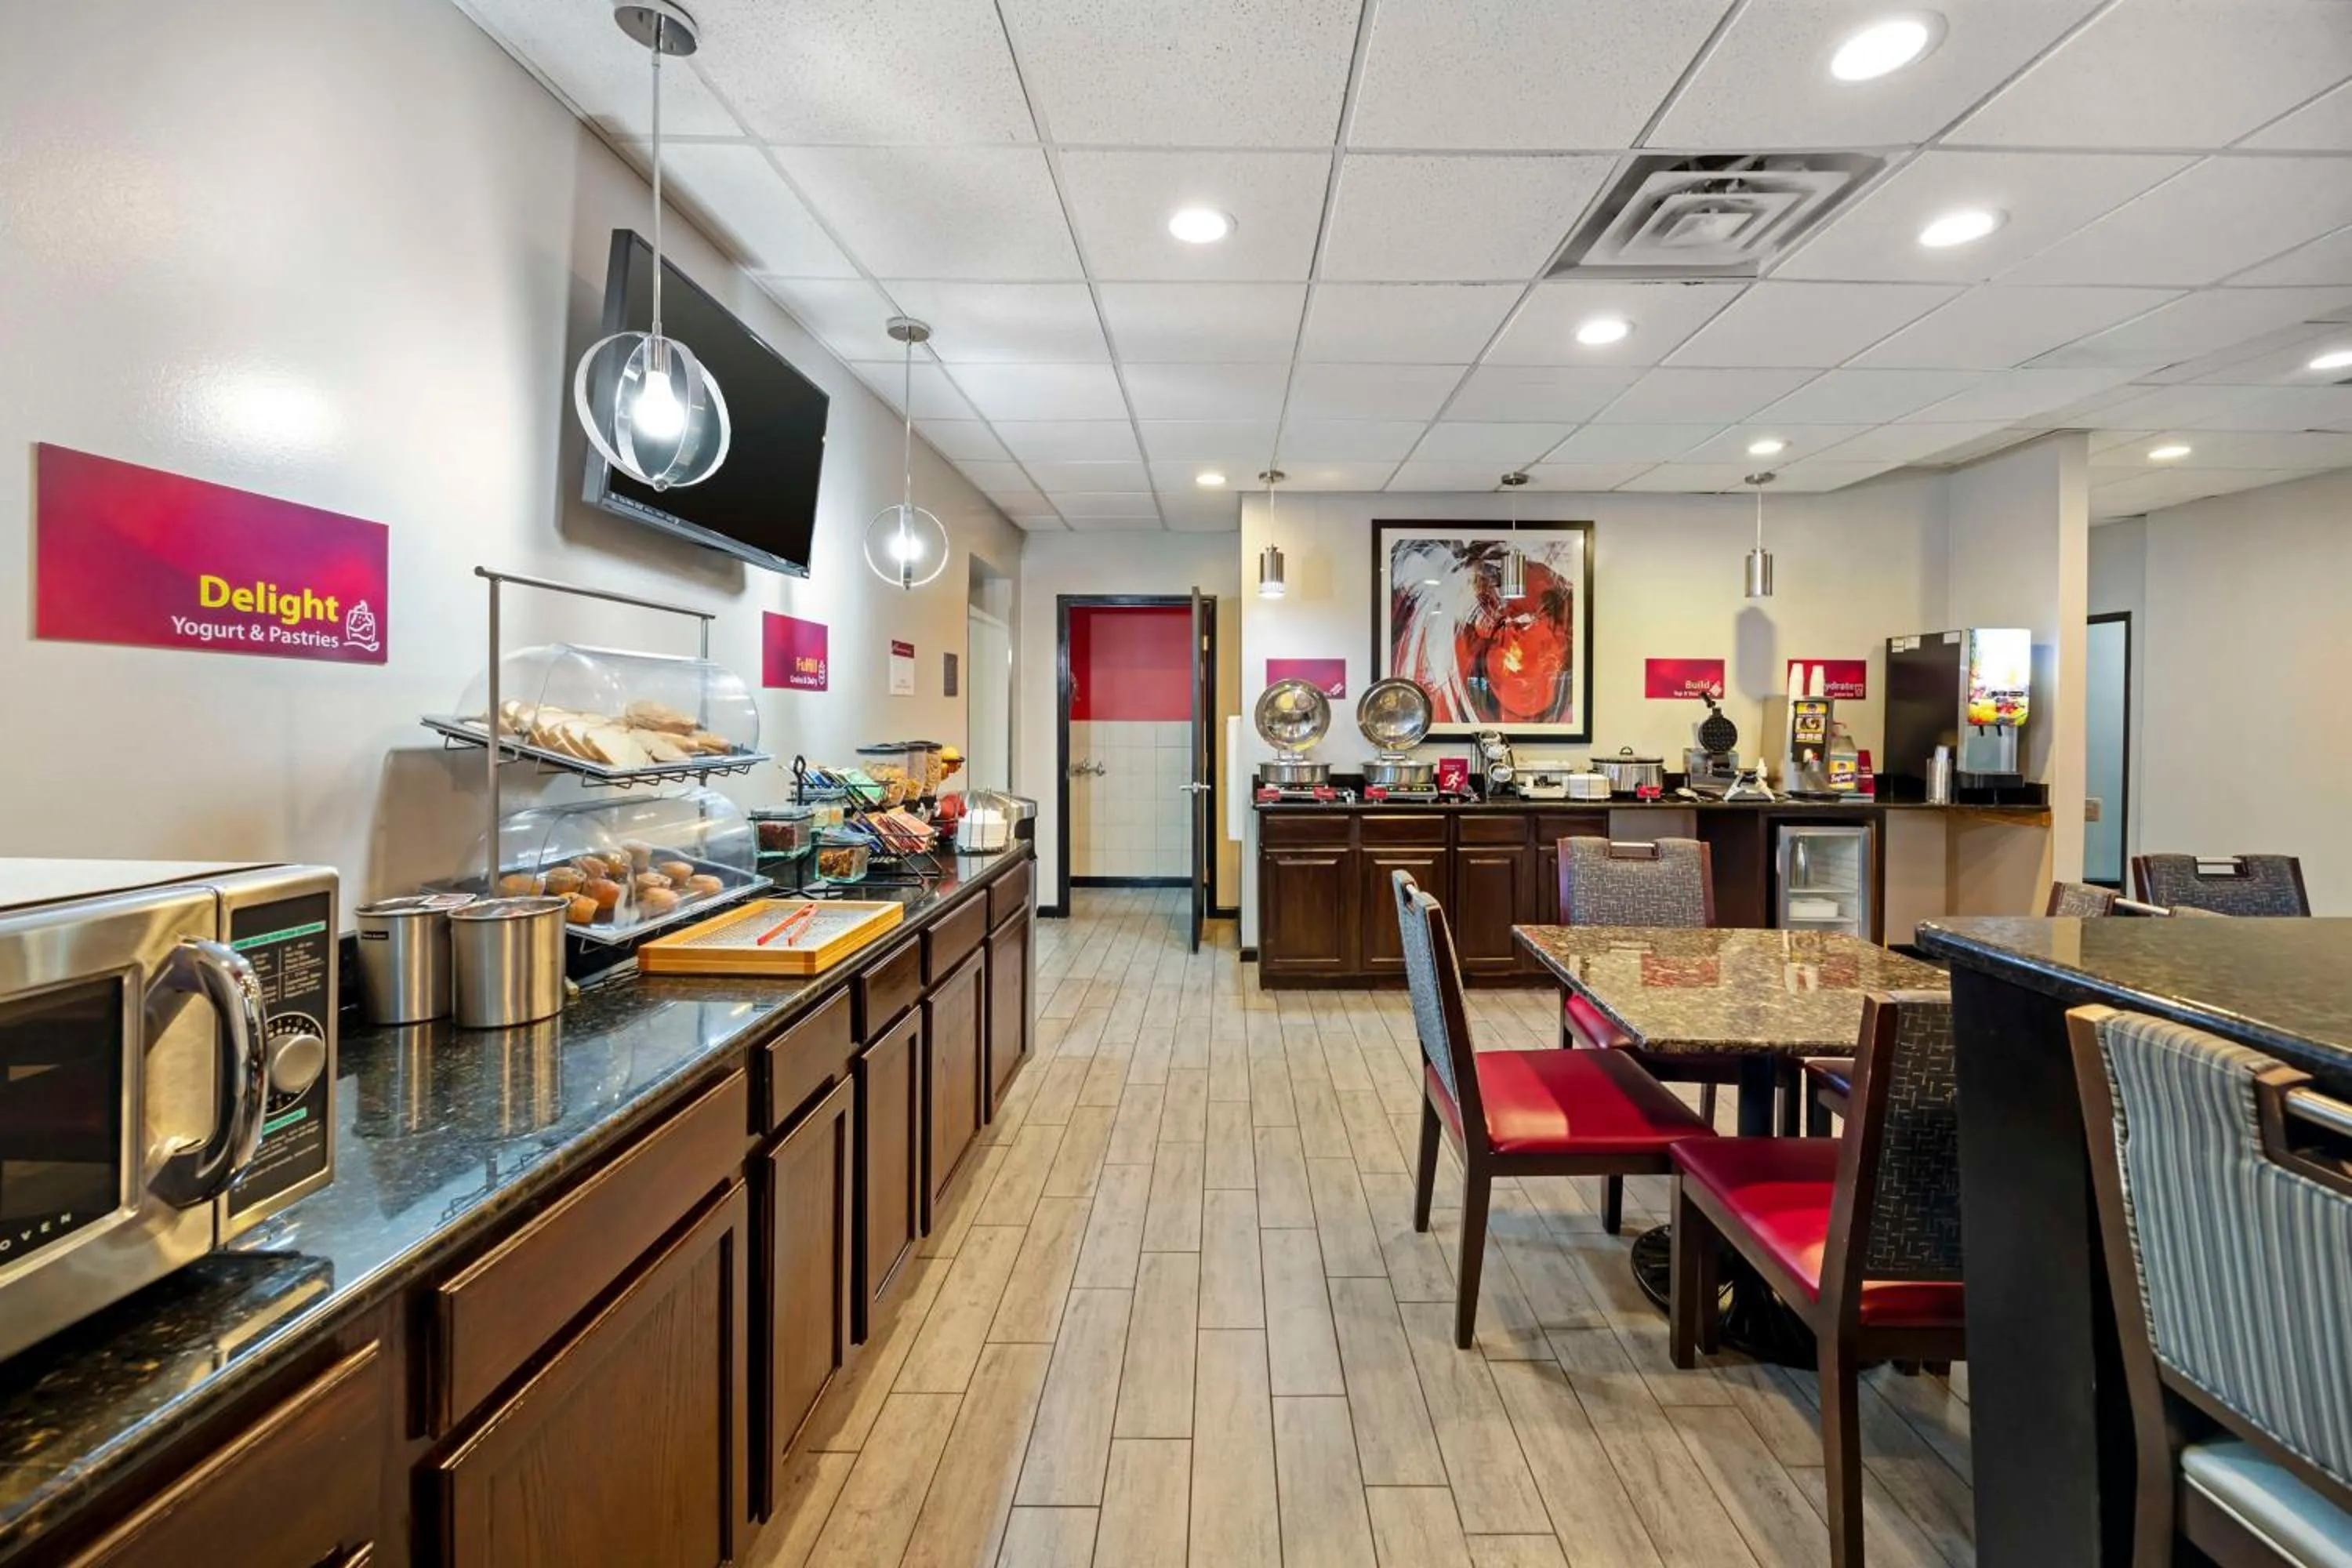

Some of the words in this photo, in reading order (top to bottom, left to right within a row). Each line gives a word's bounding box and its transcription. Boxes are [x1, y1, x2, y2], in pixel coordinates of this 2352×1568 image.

[200, 574, 339, 625] Delight
[171, 615, 245, 641] Yogurt
[249, 624, 264, 641] &
[269, 626, 339, 648] Pastries
[1685, 680, 1710, 689] Build
[1824, 681, 1854, 692] ydrate
